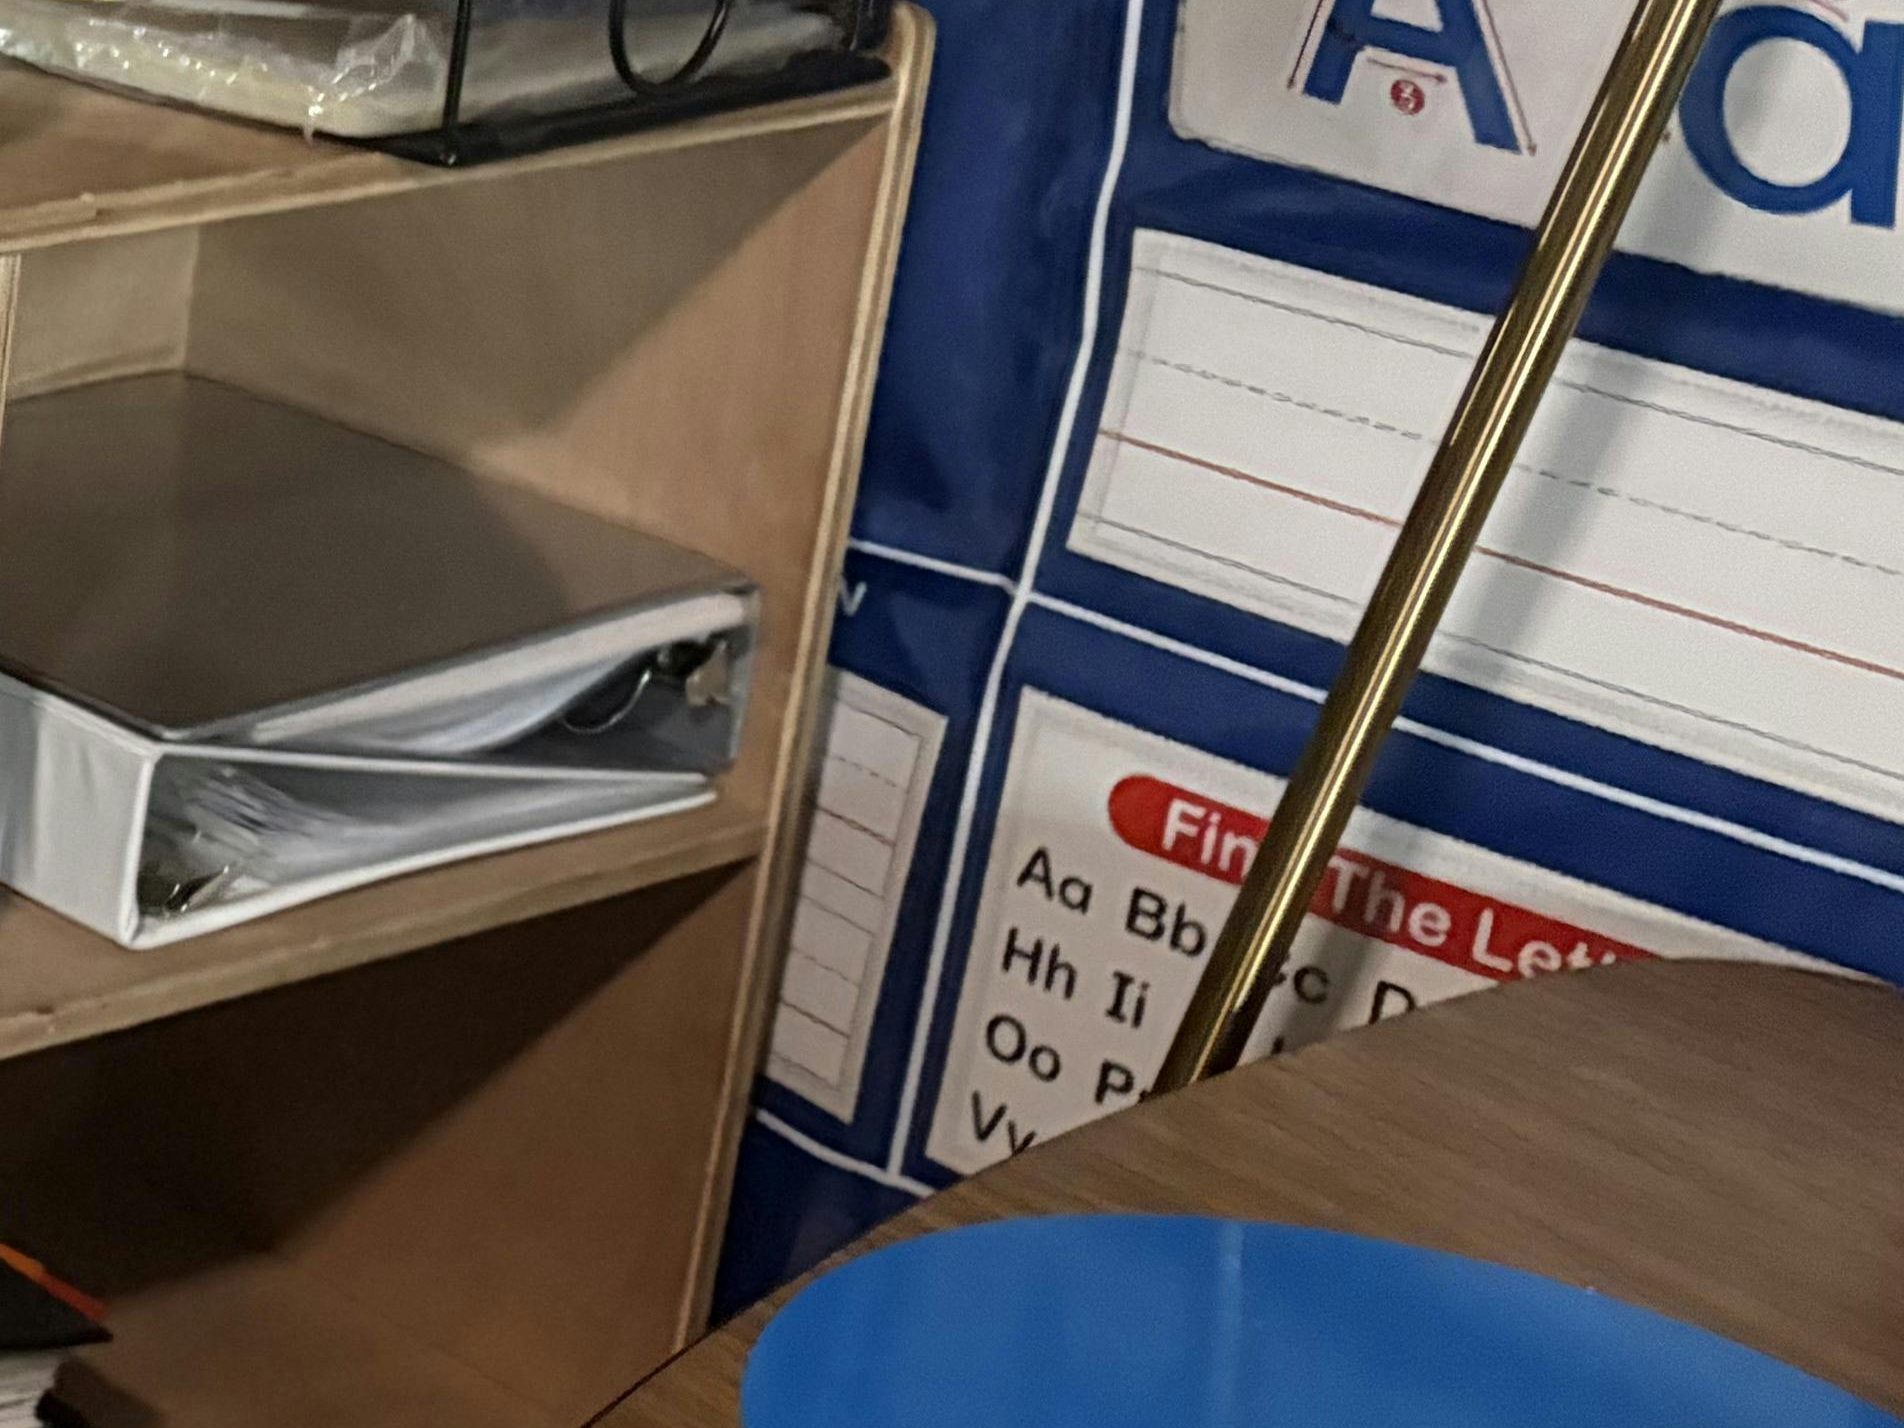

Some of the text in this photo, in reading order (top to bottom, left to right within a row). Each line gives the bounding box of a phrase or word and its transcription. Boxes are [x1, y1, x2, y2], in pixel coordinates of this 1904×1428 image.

[1016, 846, 1093, 915] Aa
[1125, 886, 1210, 959] Bb
[1160, 798, 1264, 874] Fin
[1327, 854, 1454, 949] The
[1001, 927, 1151, 1030] Hh Ii
[985, 1013, 1061, 1083] Oo
